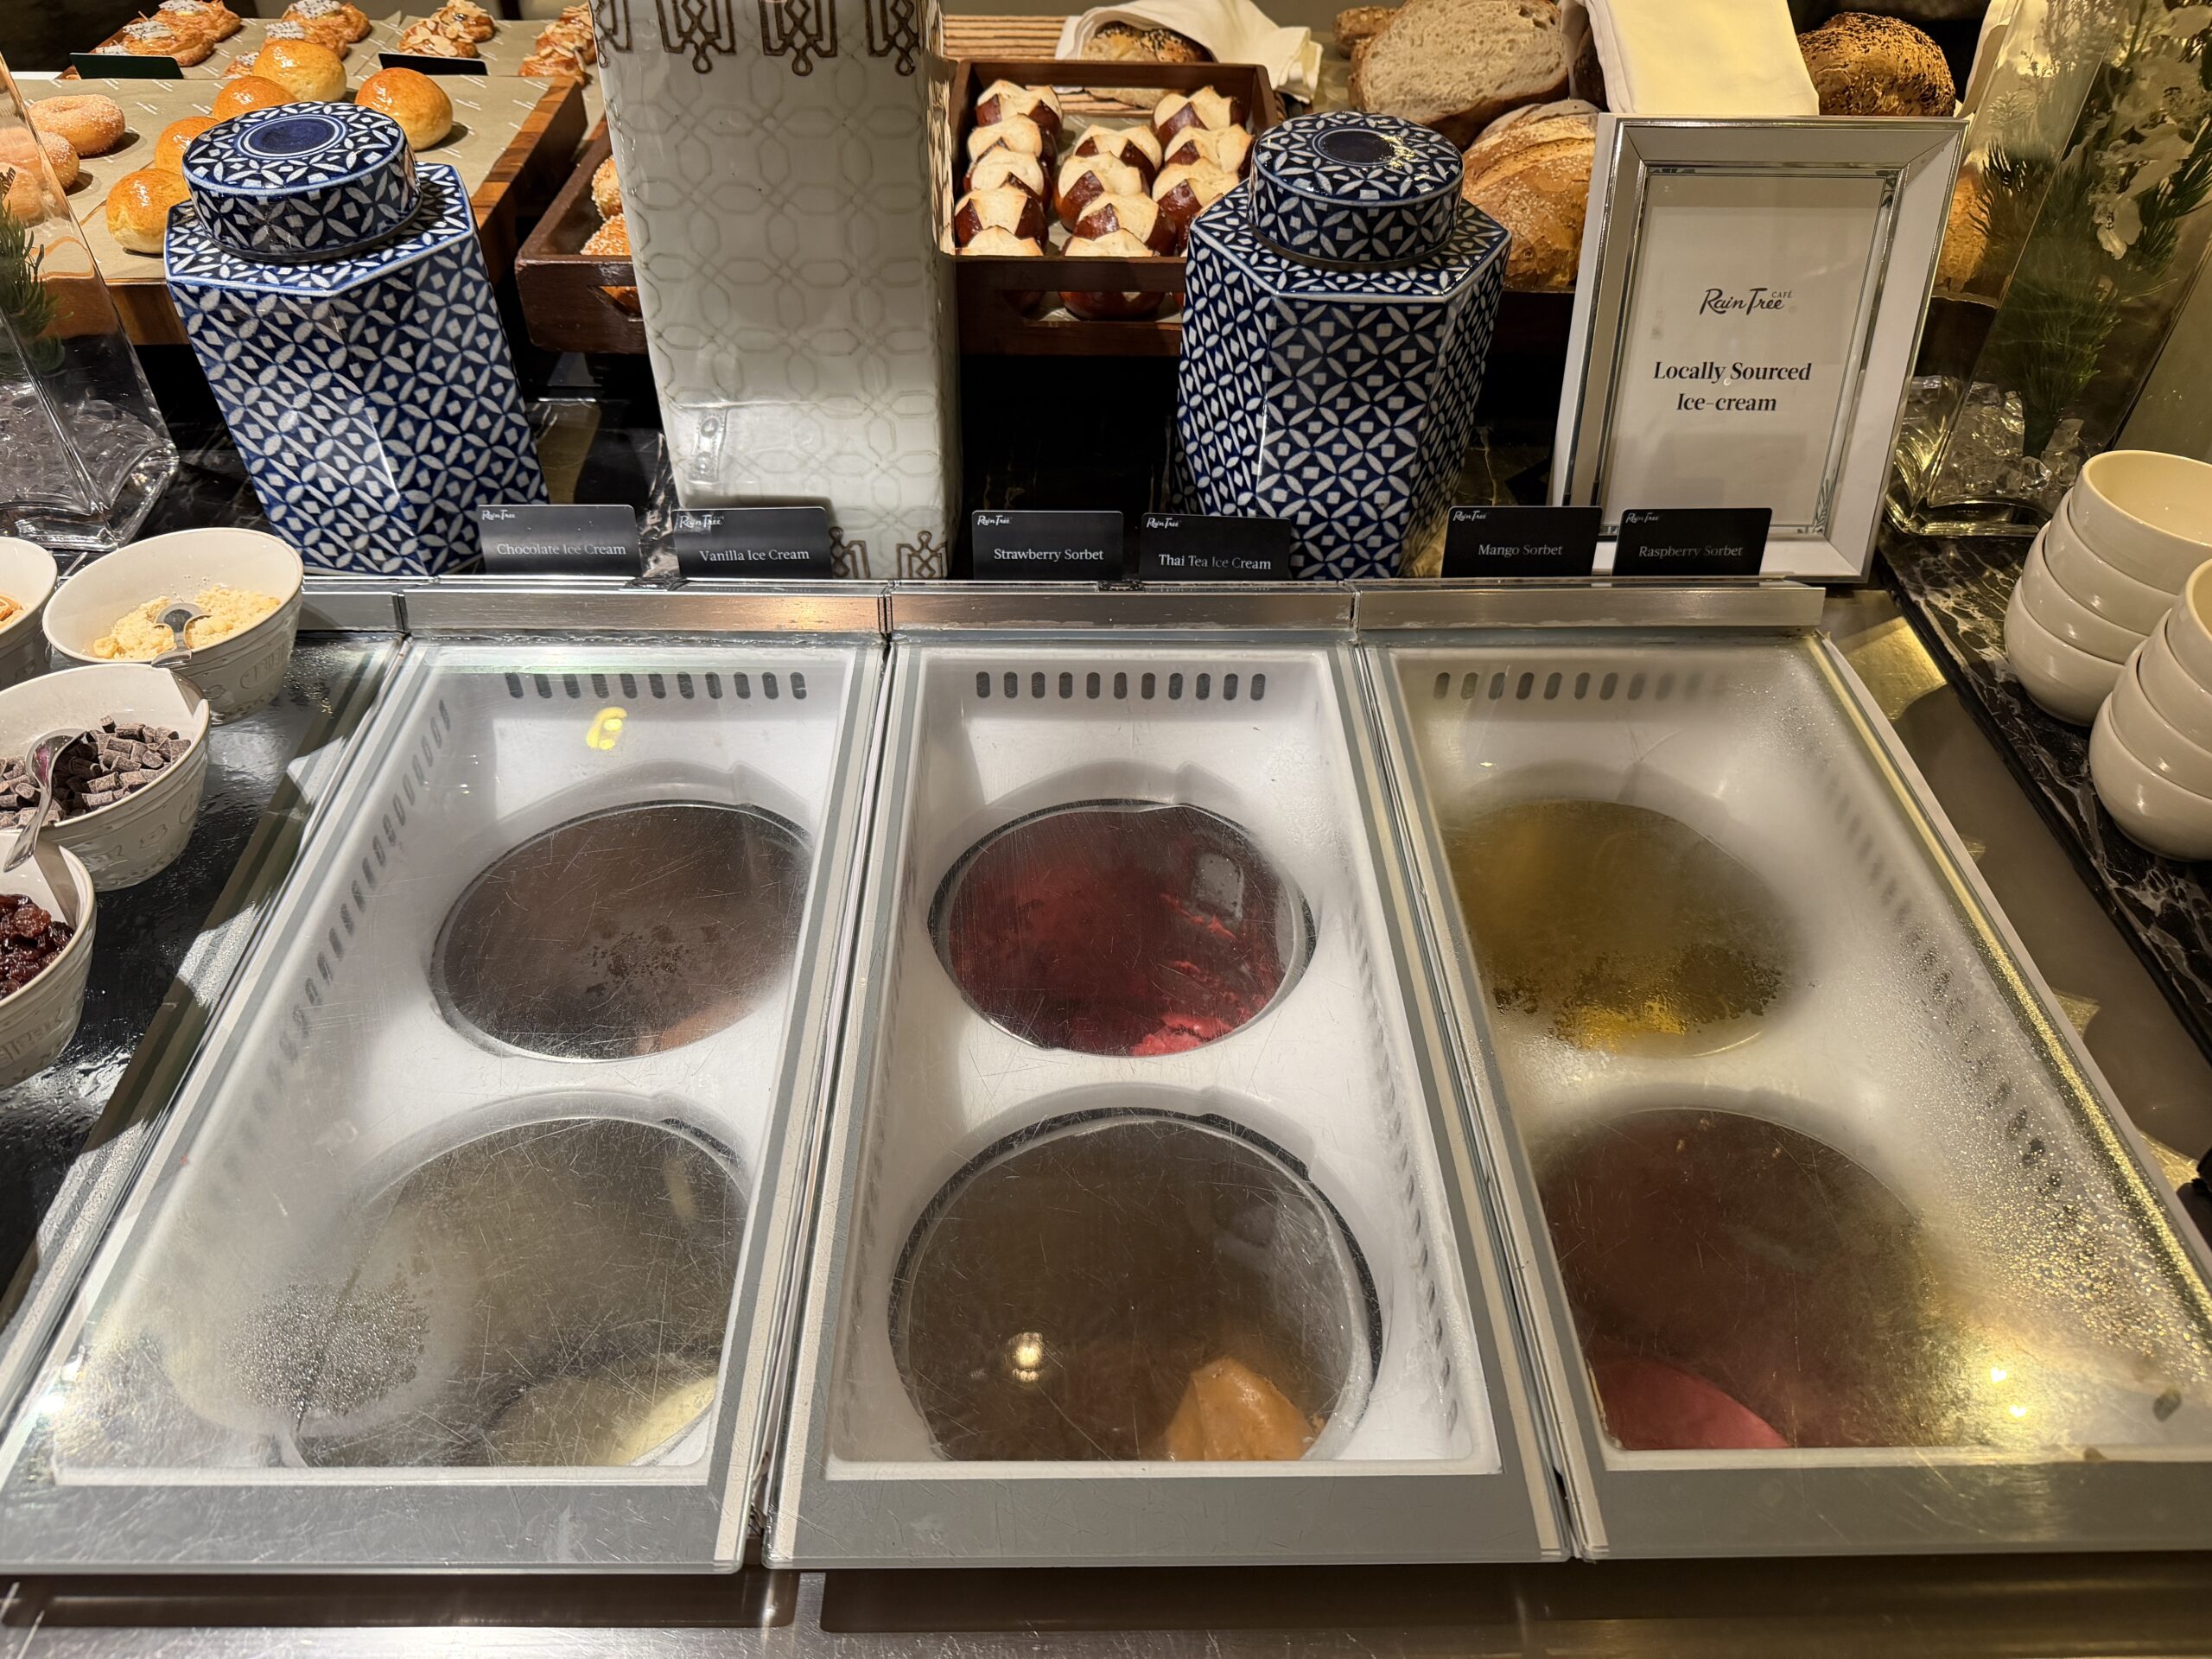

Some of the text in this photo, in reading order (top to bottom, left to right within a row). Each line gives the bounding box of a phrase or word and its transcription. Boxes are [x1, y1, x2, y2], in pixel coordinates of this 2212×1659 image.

[1699, 289, 1745, 315] Rain
[1746, 288, 1784, 315] Tree
[1653, 361, 1812, 384] Locally Sourced
[1676, 393, 1777, 411] Ice-cream
[679, 515, 722, 529] Rain Tree
[497, 543, 626, 555] Chocolate Ice Cream
[699, 550, 810, 562] Vanilla Ice Cream
[994, 549, 1104, 562] Strawberry Sorbet
[1478, 543, 1563, 557] Mango Sorbet
[1639, 545, 1744, 558] Raspberry Sorbet
[1159, 554, 1272, 569] Thai Tea Ice Cream
